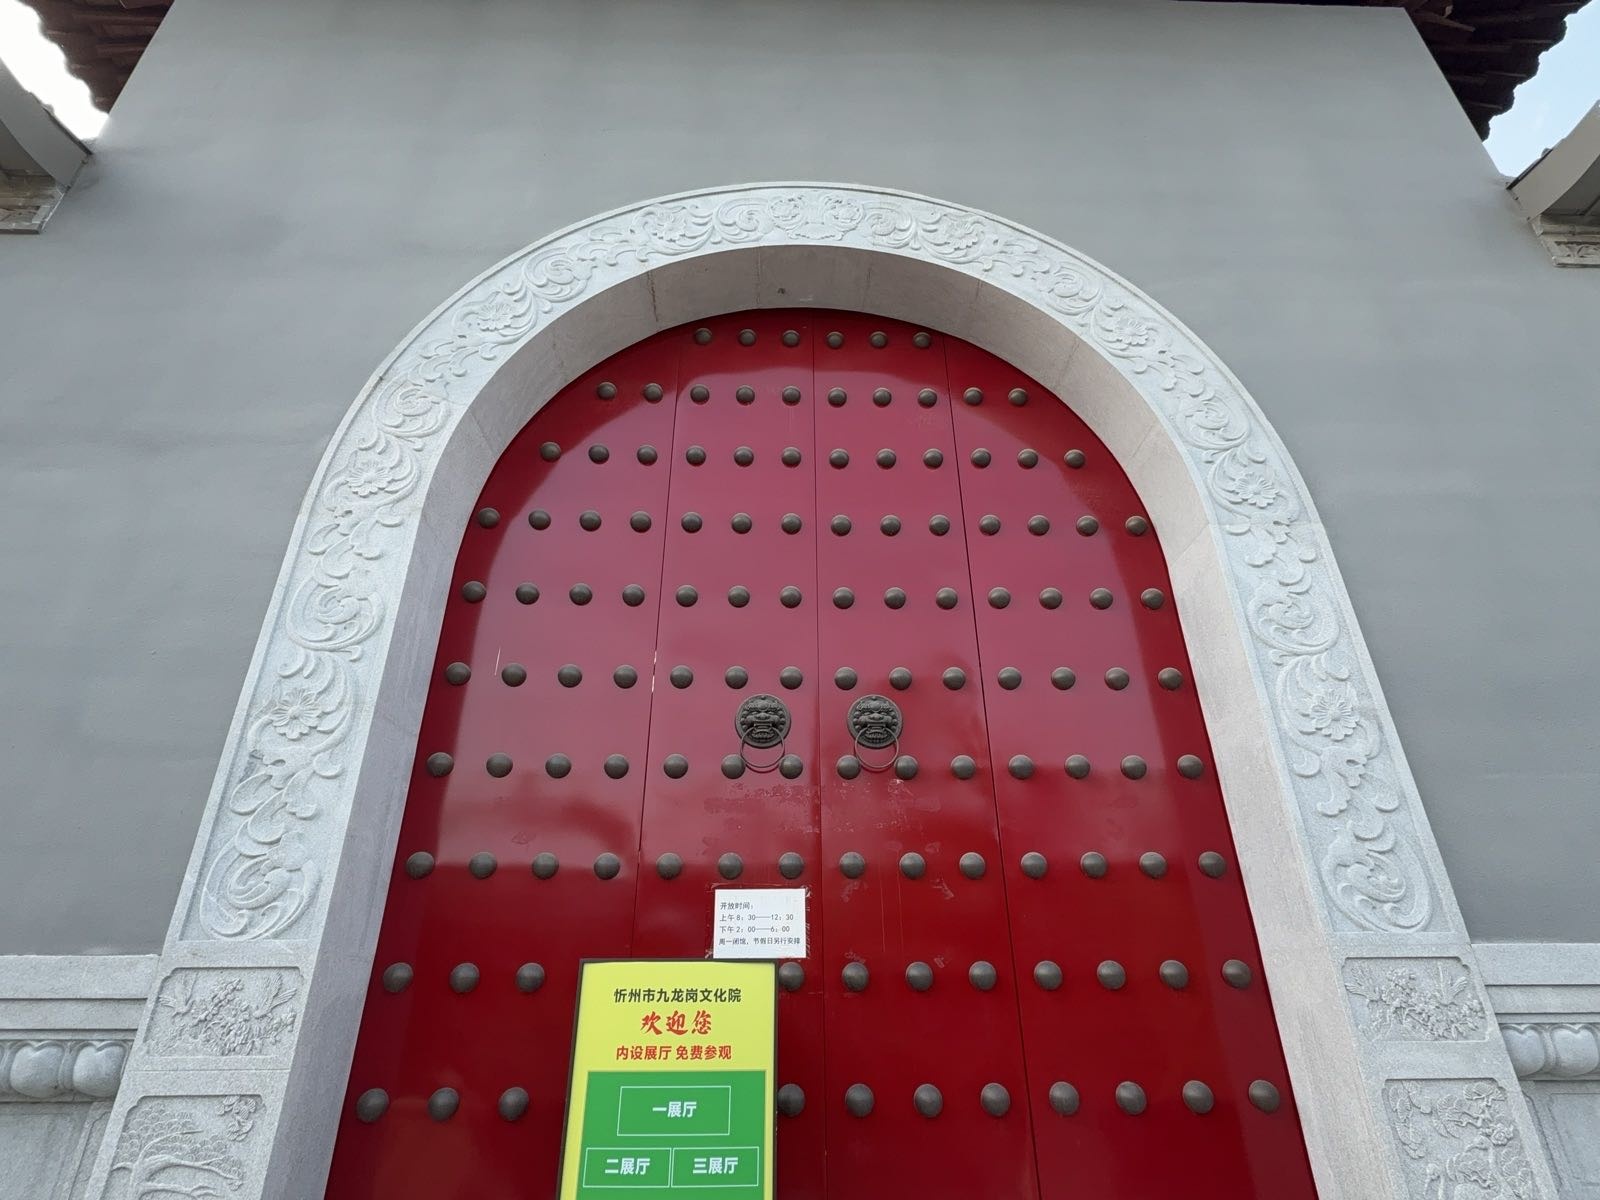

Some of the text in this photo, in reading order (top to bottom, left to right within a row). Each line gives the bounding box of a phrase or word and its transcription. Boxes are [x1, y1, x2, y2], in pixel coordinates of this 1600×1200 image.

[614, 988, 742, 1003] 忻州市九龙岗文化院
[640, 1009, 712, 1036] 欢迎您
[616, 1045, 732, 1060] 内设展厅 免费参观
[652, 1101, 697, 1118] 一展厅
[604, 1157, 651, 1175] 二展厅
[692, 1156, 739, 1175] 三展厅
